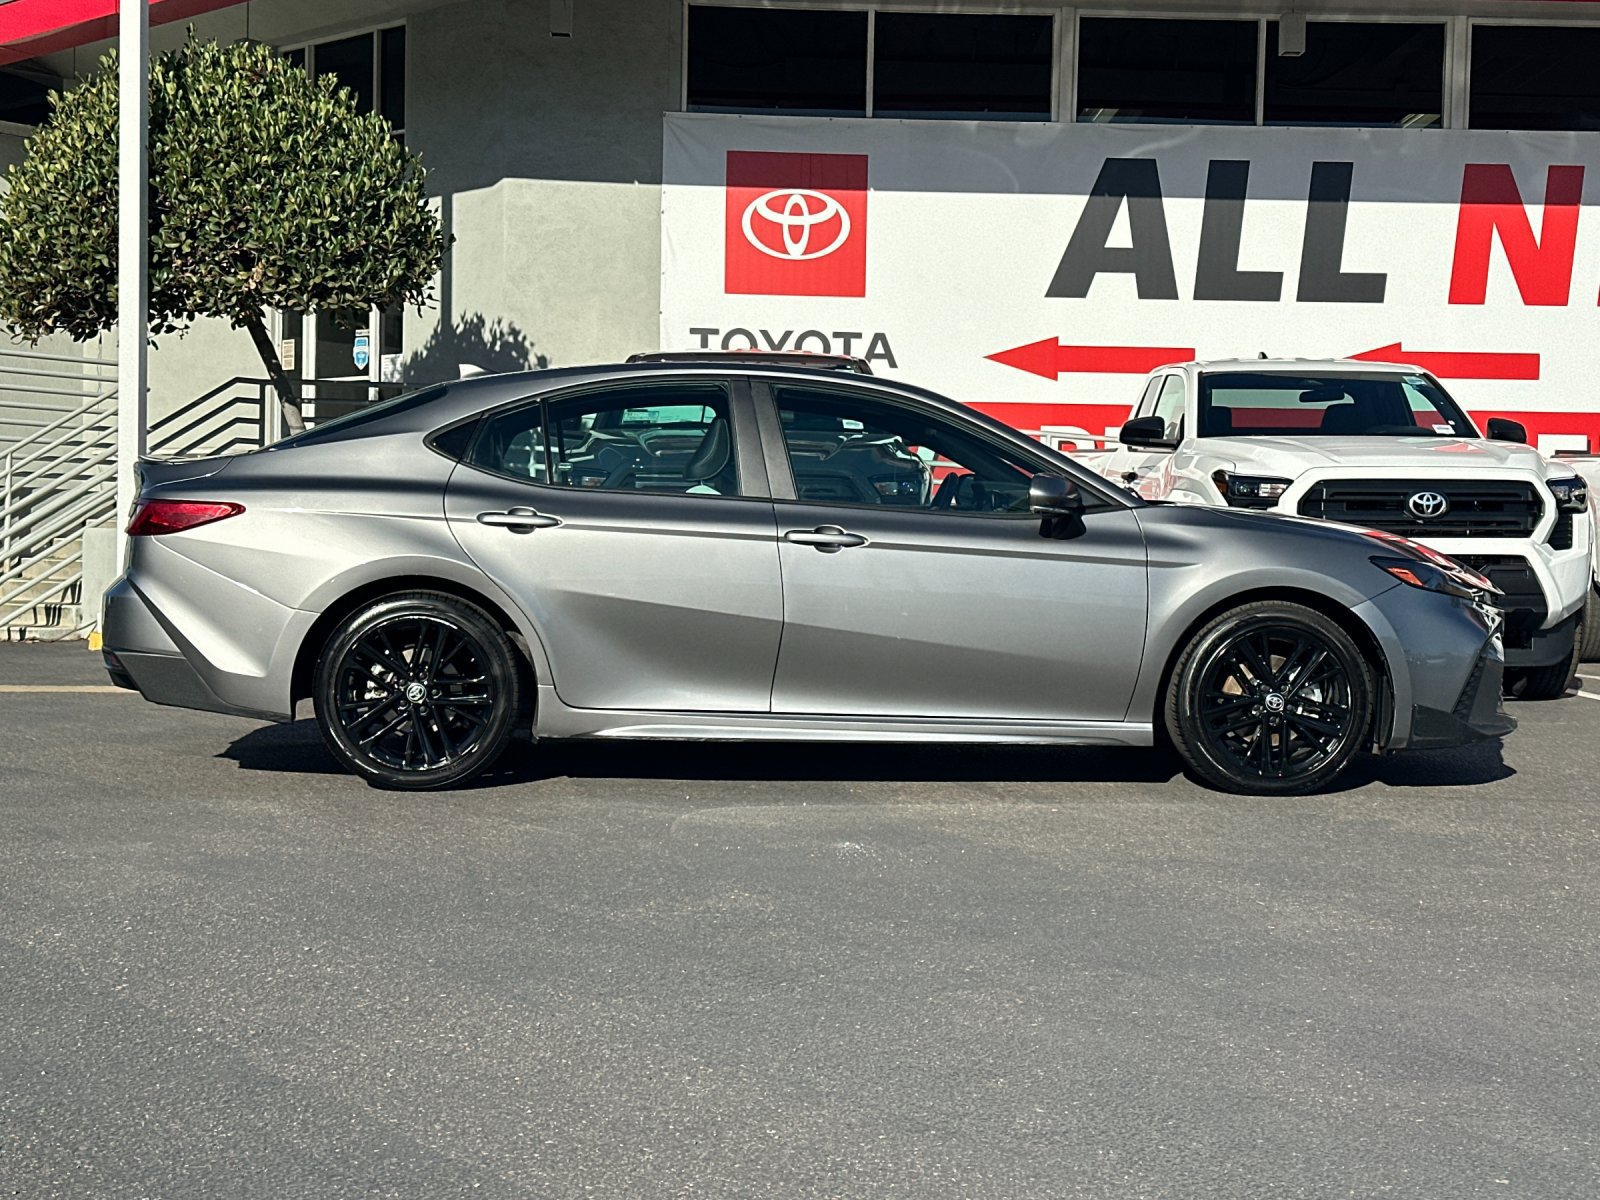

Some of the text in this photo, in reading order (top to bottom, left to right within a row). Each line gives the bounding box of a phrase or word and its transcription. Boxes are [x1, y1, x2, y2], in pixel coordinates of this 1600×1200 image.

[1044, 157, 1600, 307] ALL N
[689, 327, 898, 369] TOYOTA
